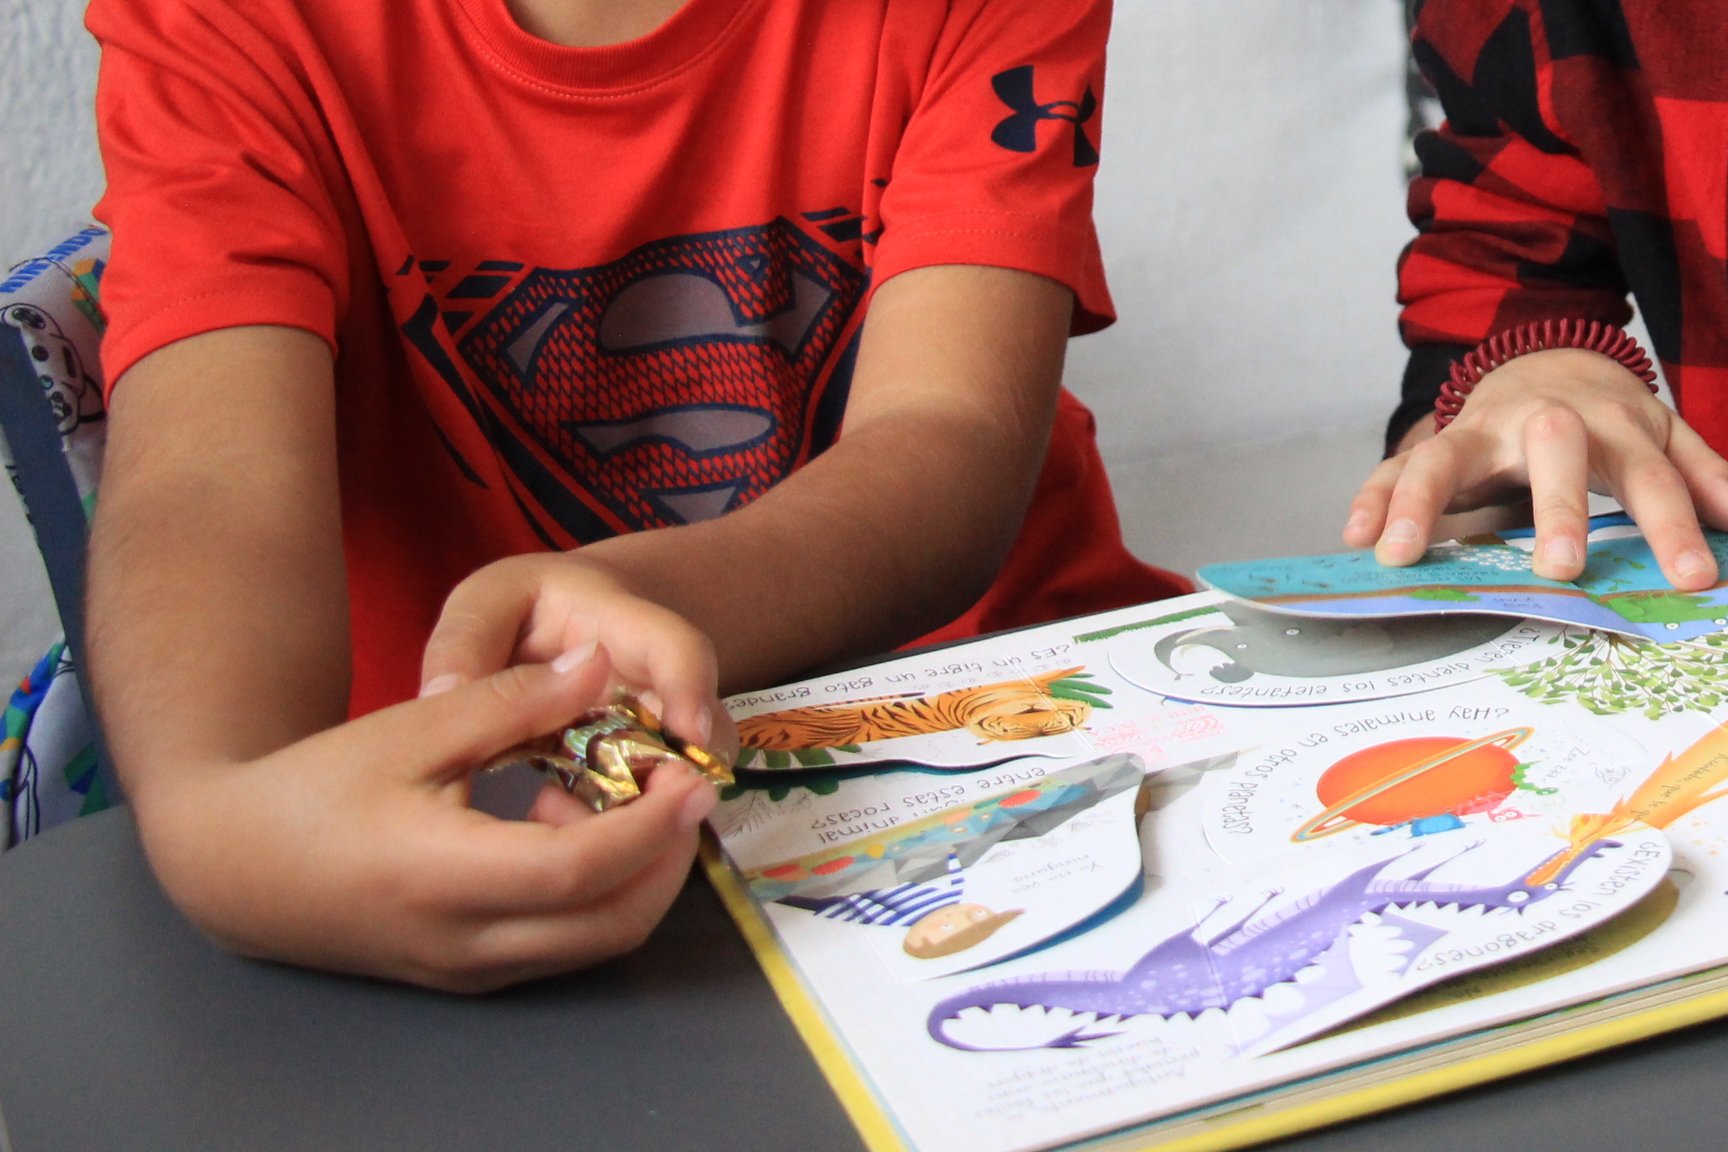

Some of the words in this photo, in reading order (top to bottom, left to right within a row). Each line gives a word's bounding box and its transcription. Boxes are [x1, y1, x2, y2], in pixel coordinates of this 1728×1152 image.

[923, 661, 982, 680] tigre
[992, 655, 1021, 671] un
[823, 675, 875, 696] gato
[885, 671, 916, 685] un
[1341, 680, 1377, 693] los
[1385, 662, 1471, 690] dientes
[1333, 709, 1435, 739] animales
[1448, 705, 1510, 720] ¿Hay
[1297, 732, 1328, 750] en
[1244, 748, 1298, 781] otros
[975, 766, 1046, 792] entre
[901, 785, 966, 810] estas
[1220, 781, 1258, 836] planetas?
[808, 802, 892, 831] rocas?
[816, 815, 900, 844] animal
[1595, 841, 1661, 900] ¿Existen
[1558, 899, 1596, 920] los
[1415, 919, 1557, 973] dragones?
